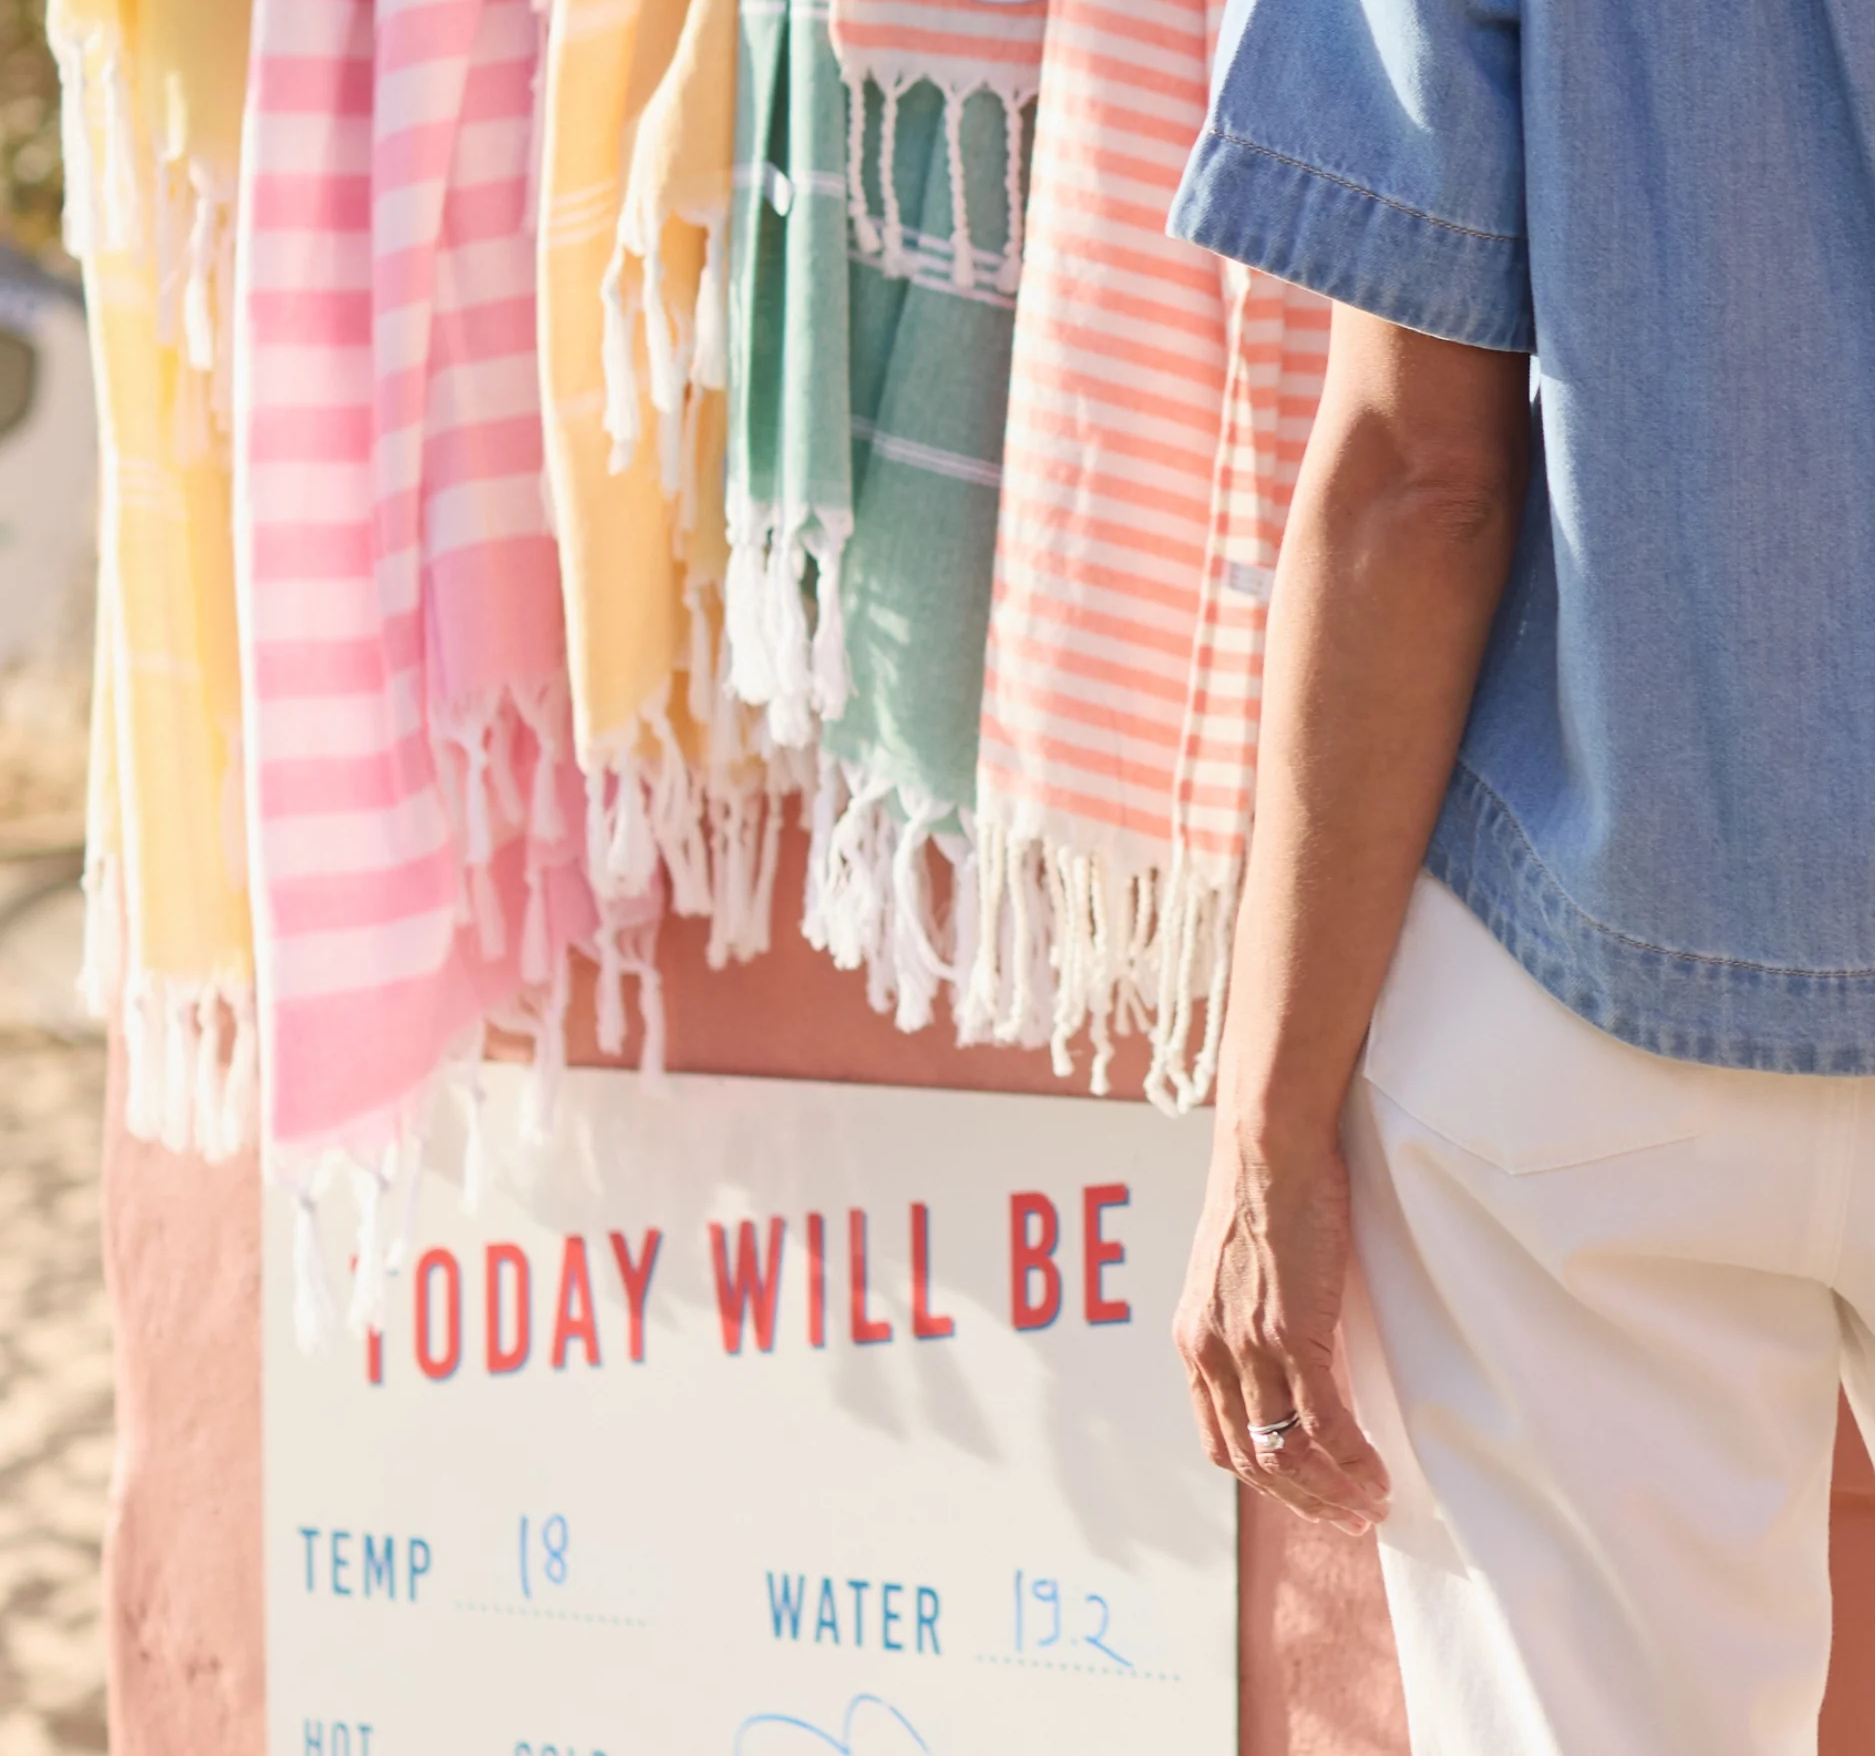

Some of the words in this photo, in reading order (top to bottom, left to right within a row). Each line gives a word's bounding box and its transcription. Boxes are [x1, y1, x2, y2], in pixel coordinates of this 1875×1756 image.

[707, 1201, 956, 1356] WILL
[1009, 1183, 1132, 1332] BE
[298, 1526, 433, 1603] TEMP
[518, 1513, 571, 1599] 18
[765, 1570, 943, 1656] WATER
